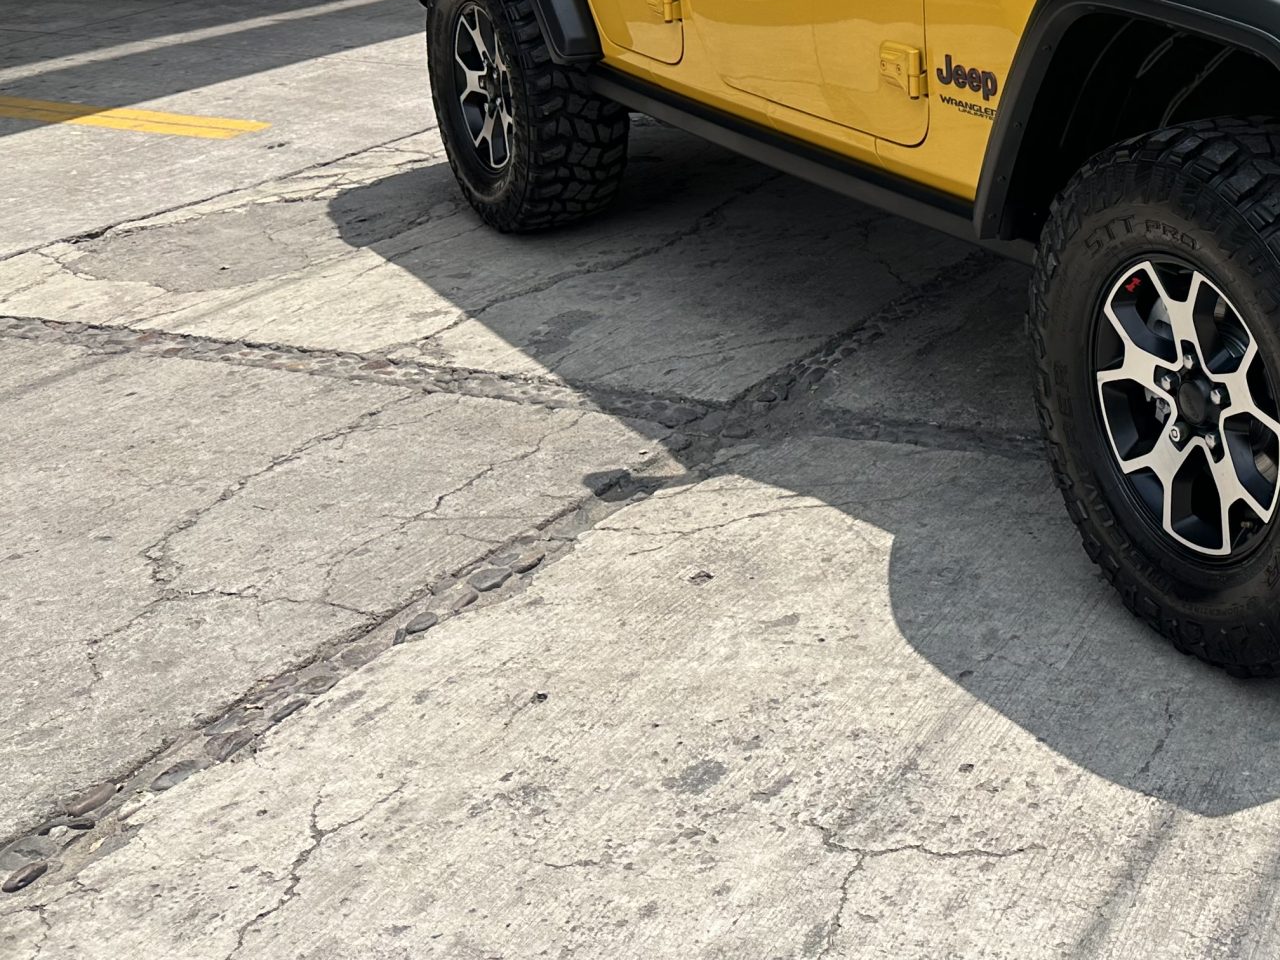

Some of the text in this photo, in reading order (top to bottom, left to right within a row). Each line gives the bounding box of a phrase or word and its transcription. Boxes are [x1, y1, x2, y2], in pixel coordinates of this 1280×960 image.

[936, 54, 998, 102] Jeep
[1084, 214, 1198, 257] STT PRO
